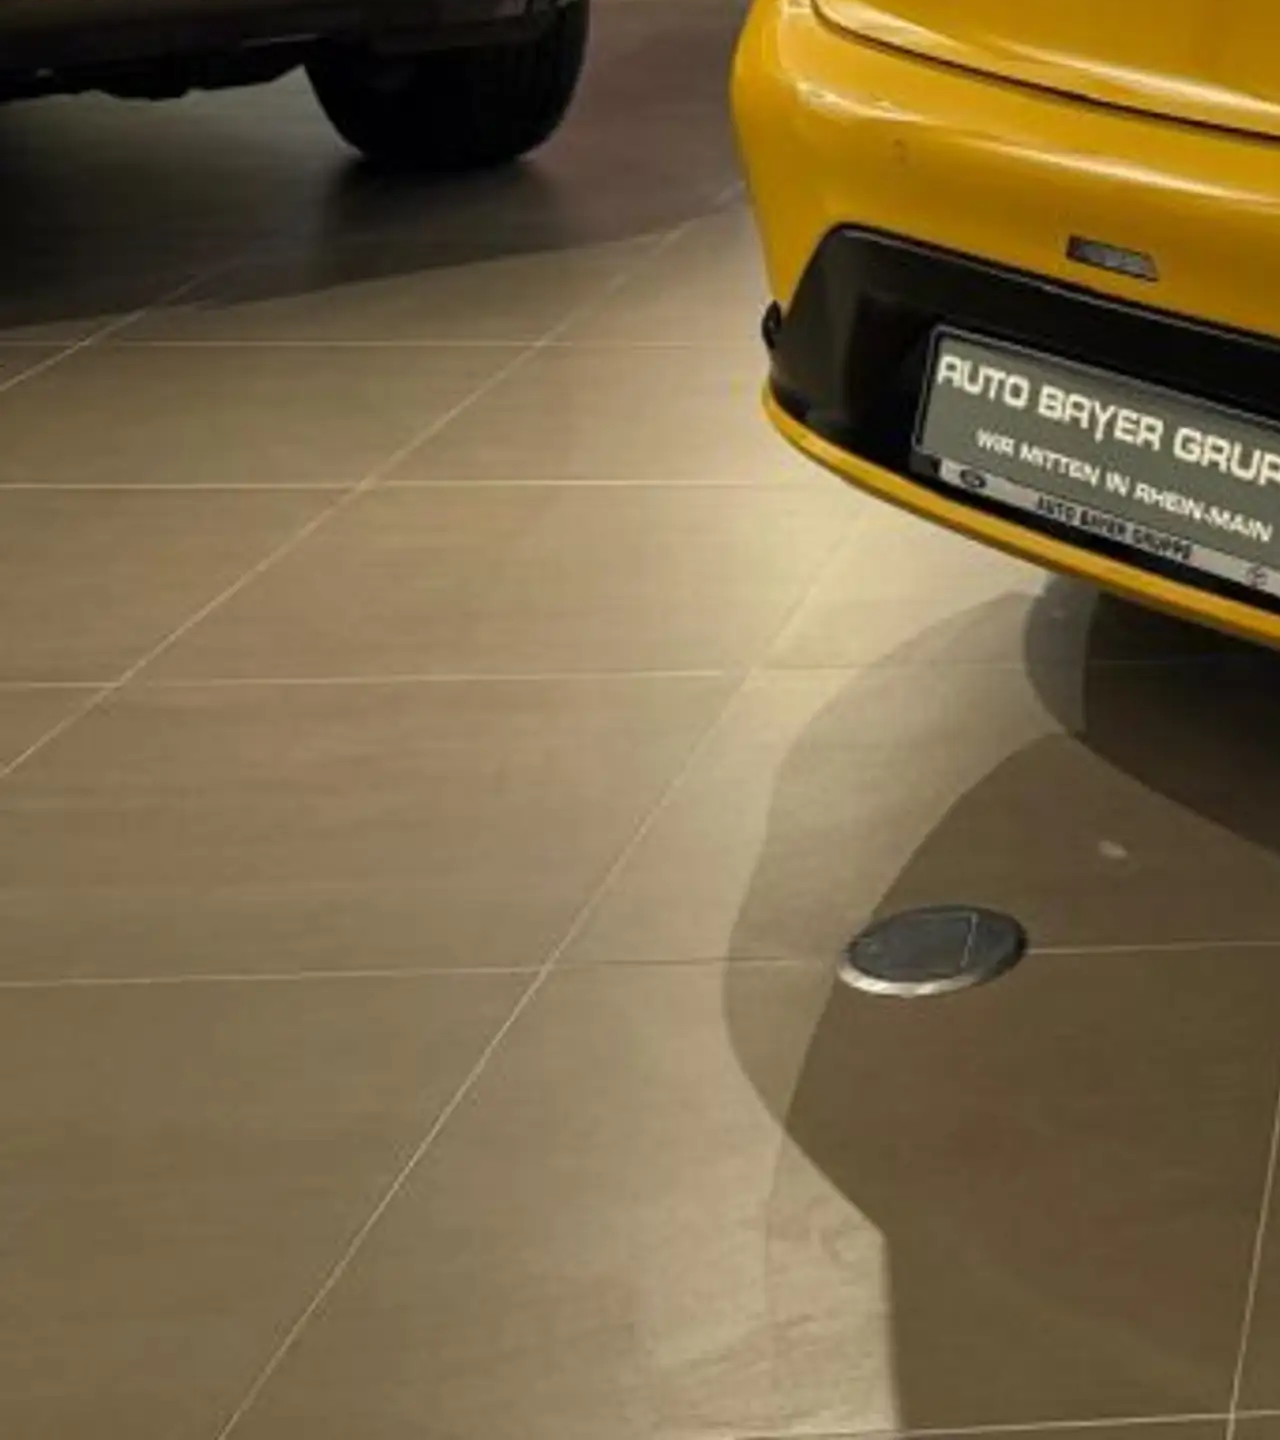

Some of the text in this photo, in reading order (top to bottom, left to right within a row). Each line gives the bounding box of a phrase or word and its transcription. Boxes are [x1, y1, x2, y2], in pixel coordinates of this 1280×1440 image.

[936, 354, 1029, 409] AUTO
[1037, 384, 1165, 452] BAYER
[974, 427, 1274, 544] WIR MITTEN IN RHEIN-MAIN
